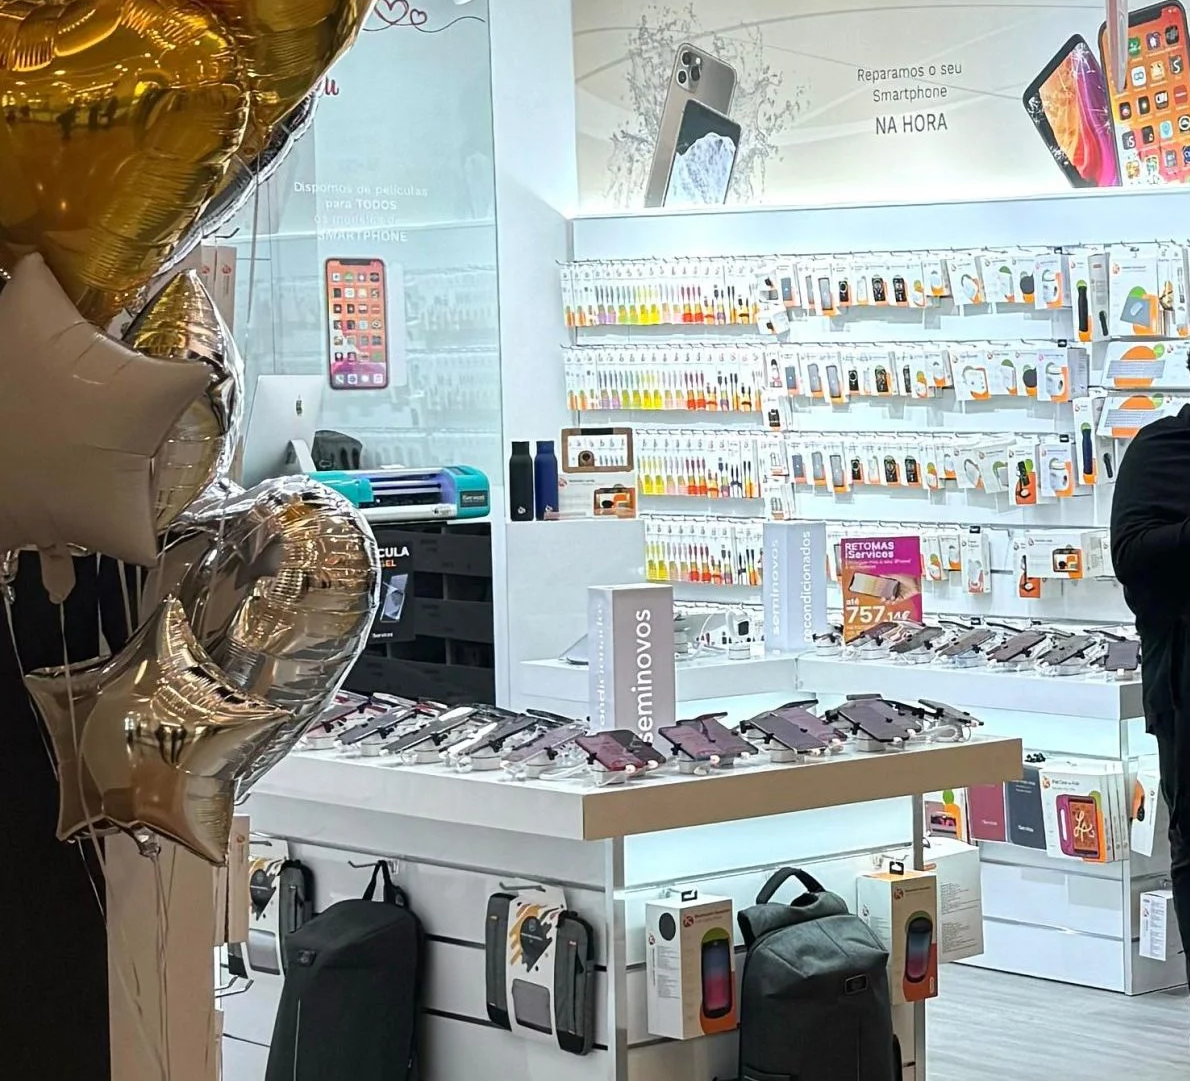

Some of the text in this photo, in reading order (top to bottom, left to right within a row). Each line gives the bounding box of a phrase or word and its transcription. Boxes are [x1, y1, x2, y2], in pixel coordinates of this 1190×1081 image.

[857, 63, 963, 82] Reparamos o seu
[873, 86, 948, 104] Smartphone
[875, 112, 948, 134] NA HORA
[326, 199, 397, 210] para TODOS
[844, 542, 895, 550] RETOMAS
[631, 608, 654, 744] seminovos
